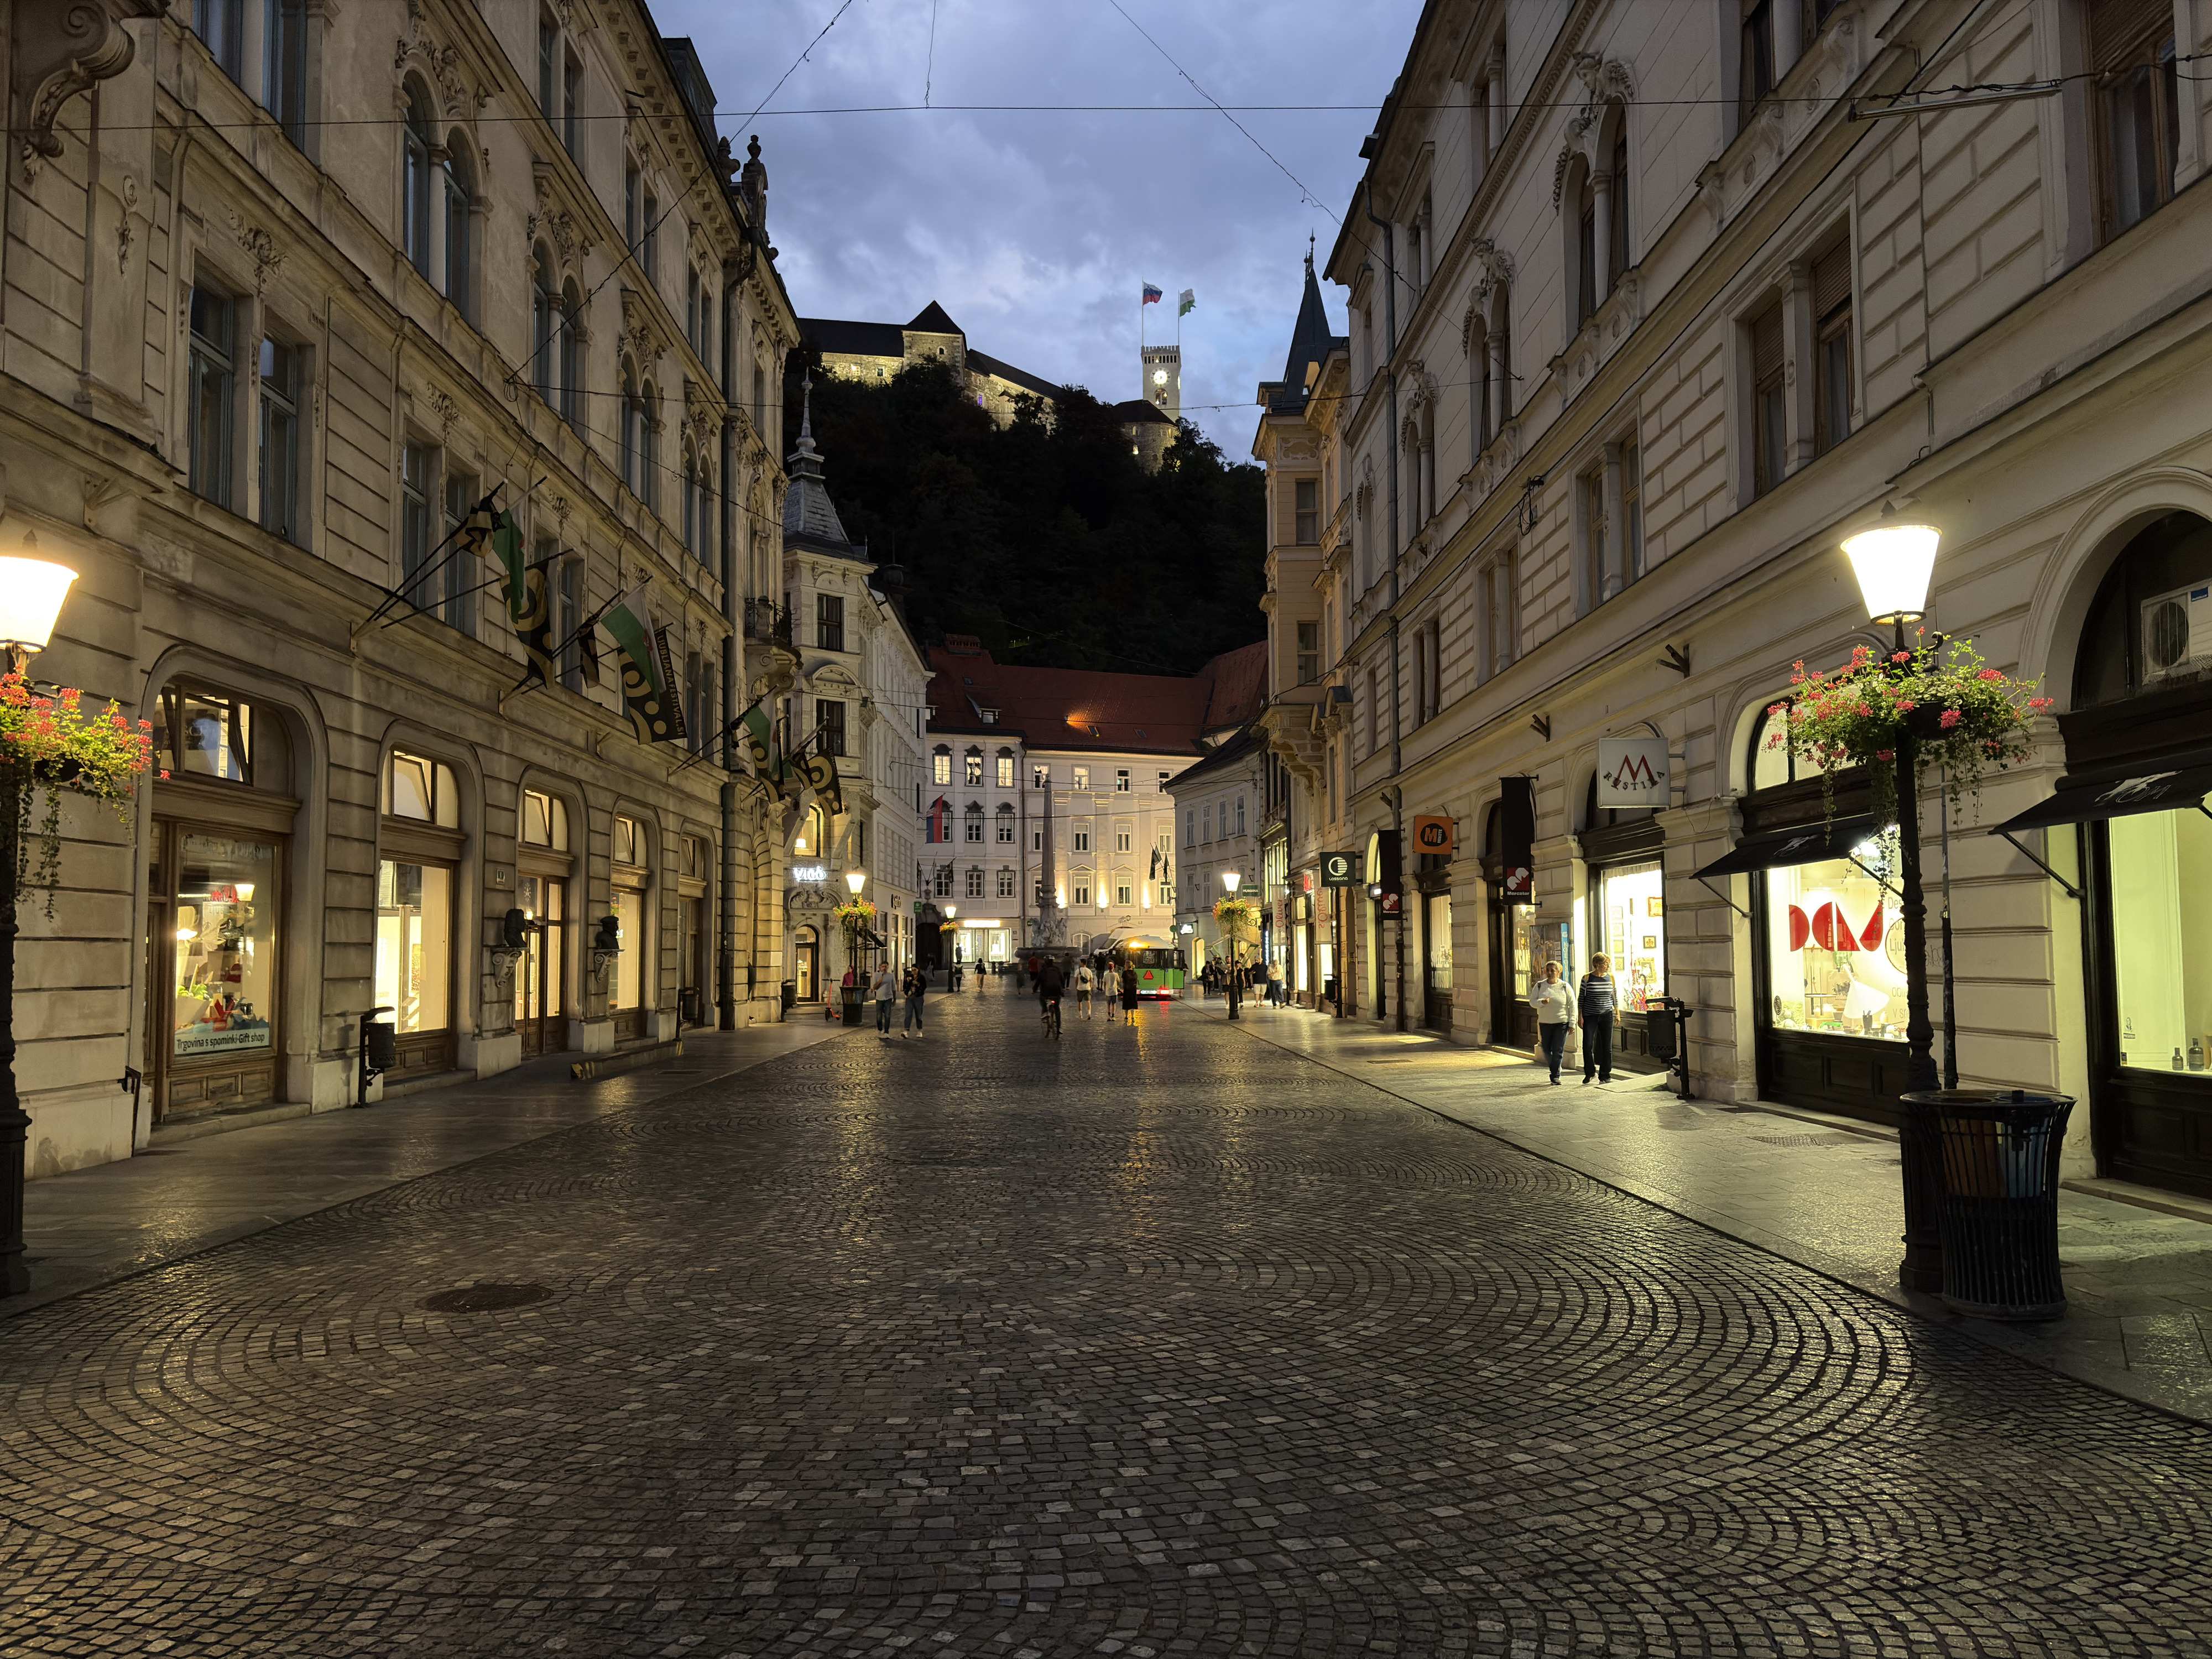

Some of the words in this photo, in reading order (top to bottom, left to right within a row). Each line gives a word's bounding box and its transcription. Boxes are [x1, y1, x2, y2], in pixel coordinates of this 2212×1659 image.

[1888, 896, 1902, 909] Des
[1515, 950, 1530, 971] VSAK
[1515, 974, 1527, 995] DAN
[176, 1037, 204, 1051] Trgovina
[251, 1032, 265, 1043] shop
